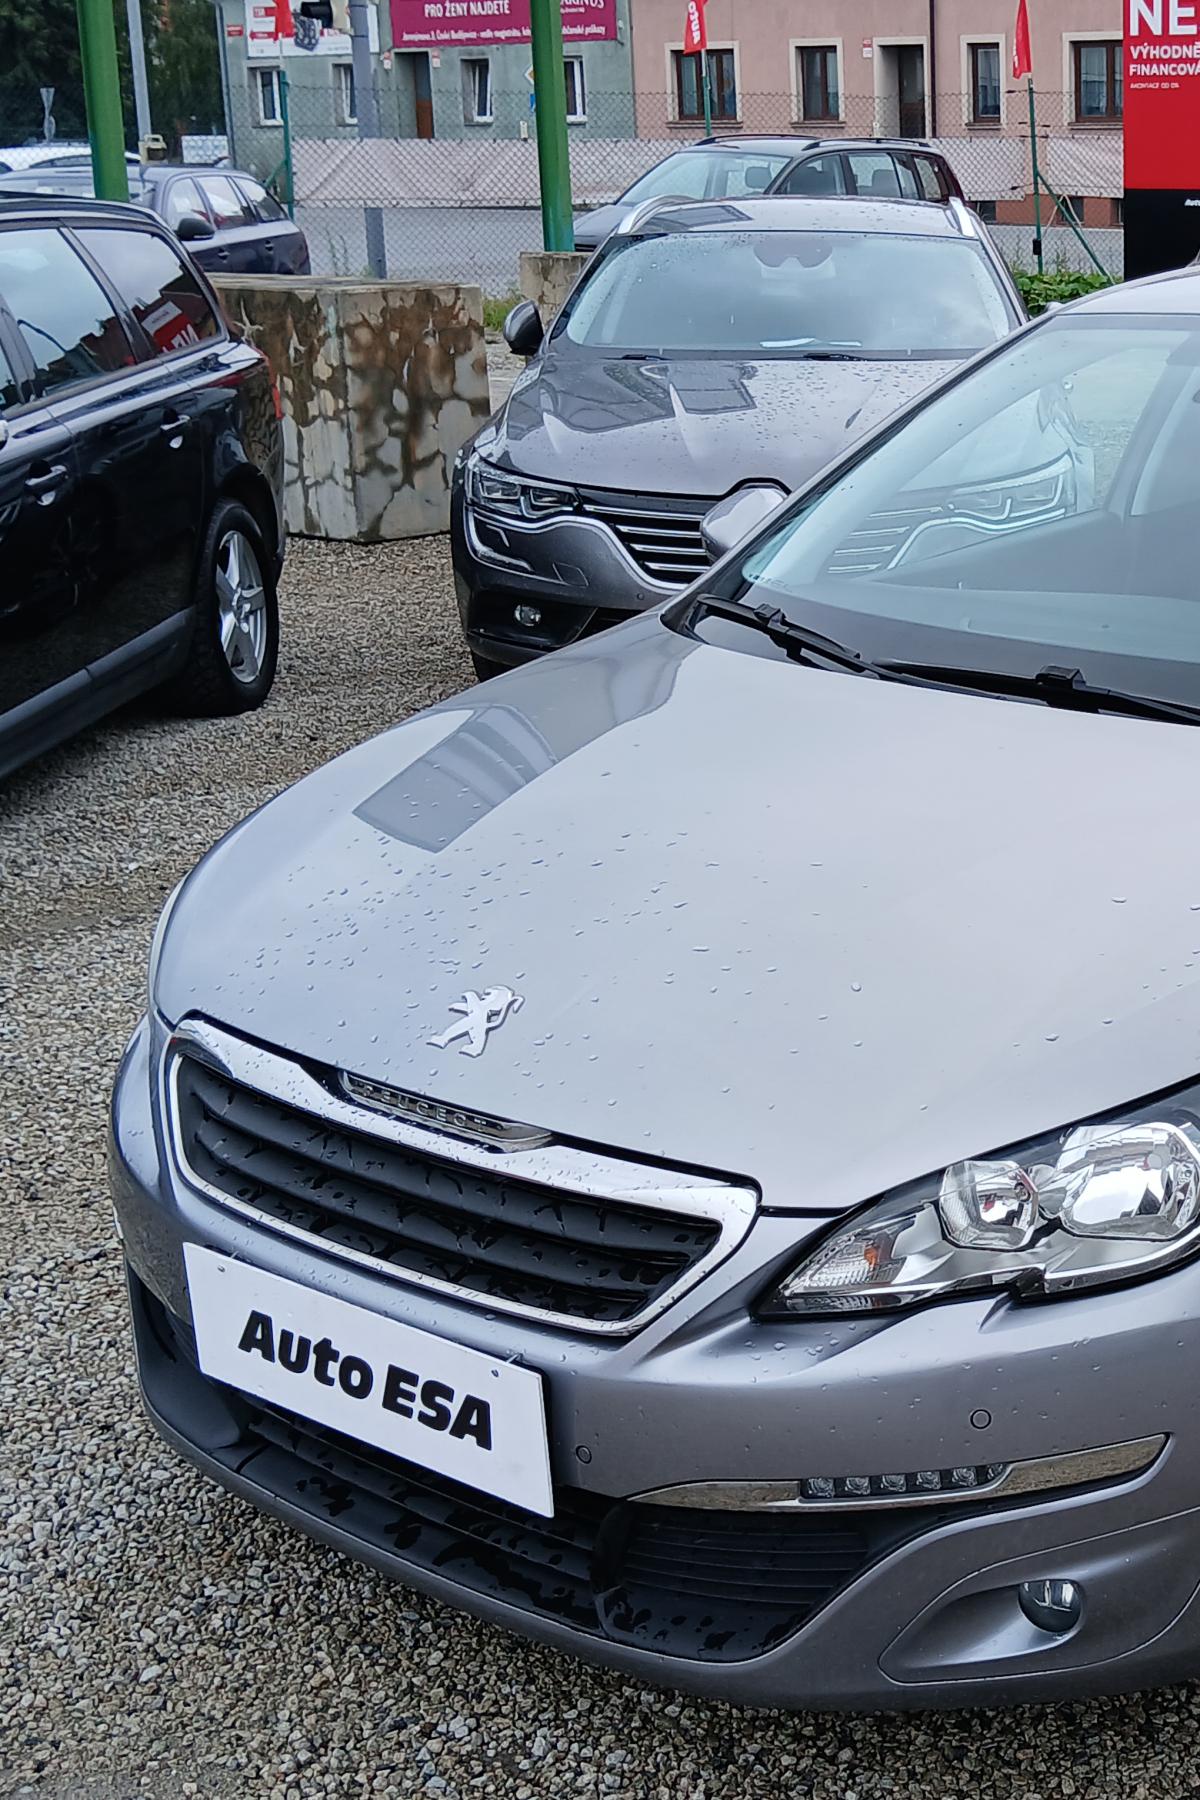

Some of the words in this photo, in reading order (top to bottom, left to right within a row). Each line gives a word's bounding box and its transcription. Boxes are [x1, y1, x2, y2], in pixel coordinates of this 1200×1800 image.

[424, 3, 444, 18] PRO
[444, 0, 468, 17] ŽENY
[469, 0, 511, 16] NAJDETE
[362, 1085, 489, 1132] PEUGEOT
[238, 1310, 374, 1400] Auto
[381, 1363, 492, 1451] ESA
